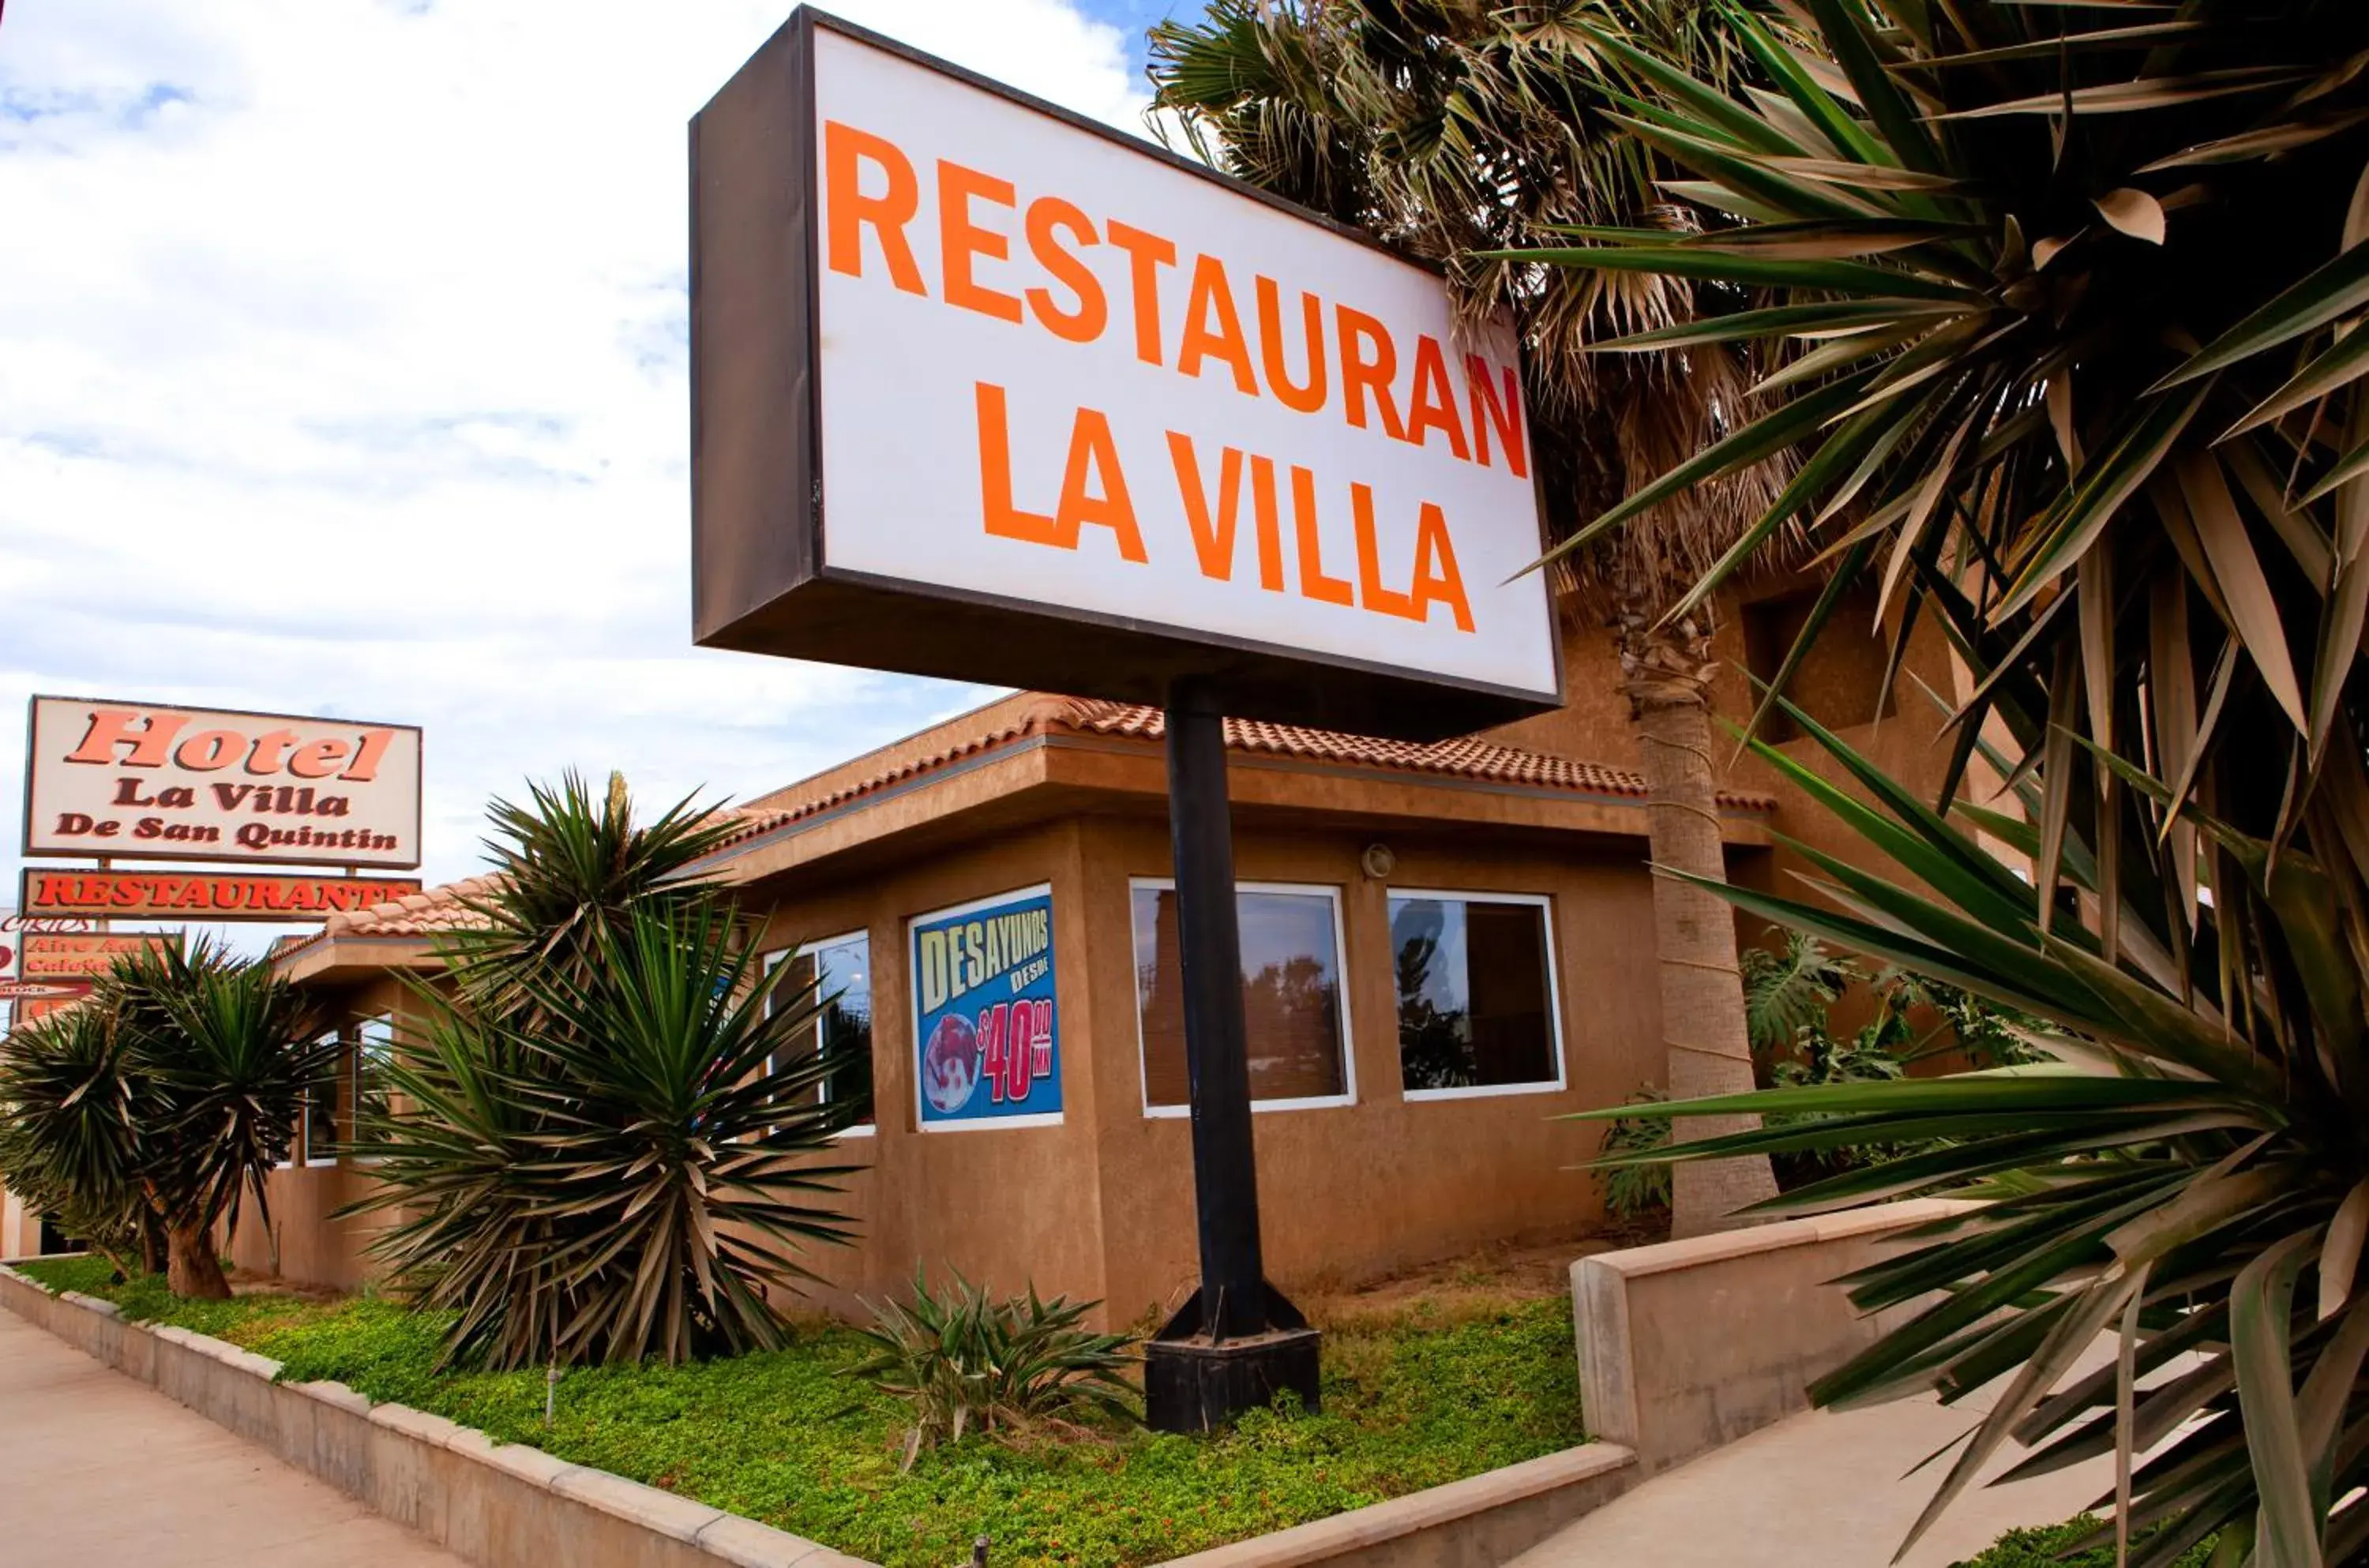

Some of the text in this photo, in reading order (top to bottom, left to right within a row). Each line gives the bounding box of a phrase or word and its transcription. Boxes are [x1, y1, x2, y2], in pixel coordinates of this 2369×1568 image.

[825, 119, 1527, 480] RESTAURAN
[975, 381, 1476, 634] LA VILLA
[63, 710, 394, 782] Hotel
[54, 813, 121, 837] De
[134, 816, 220, 842] San
[112, 778, 350, 816] La Villa
[920, 909, 1049, 1015] DESAYUNOS
[1011, 956, 1049, 994] DESDE
